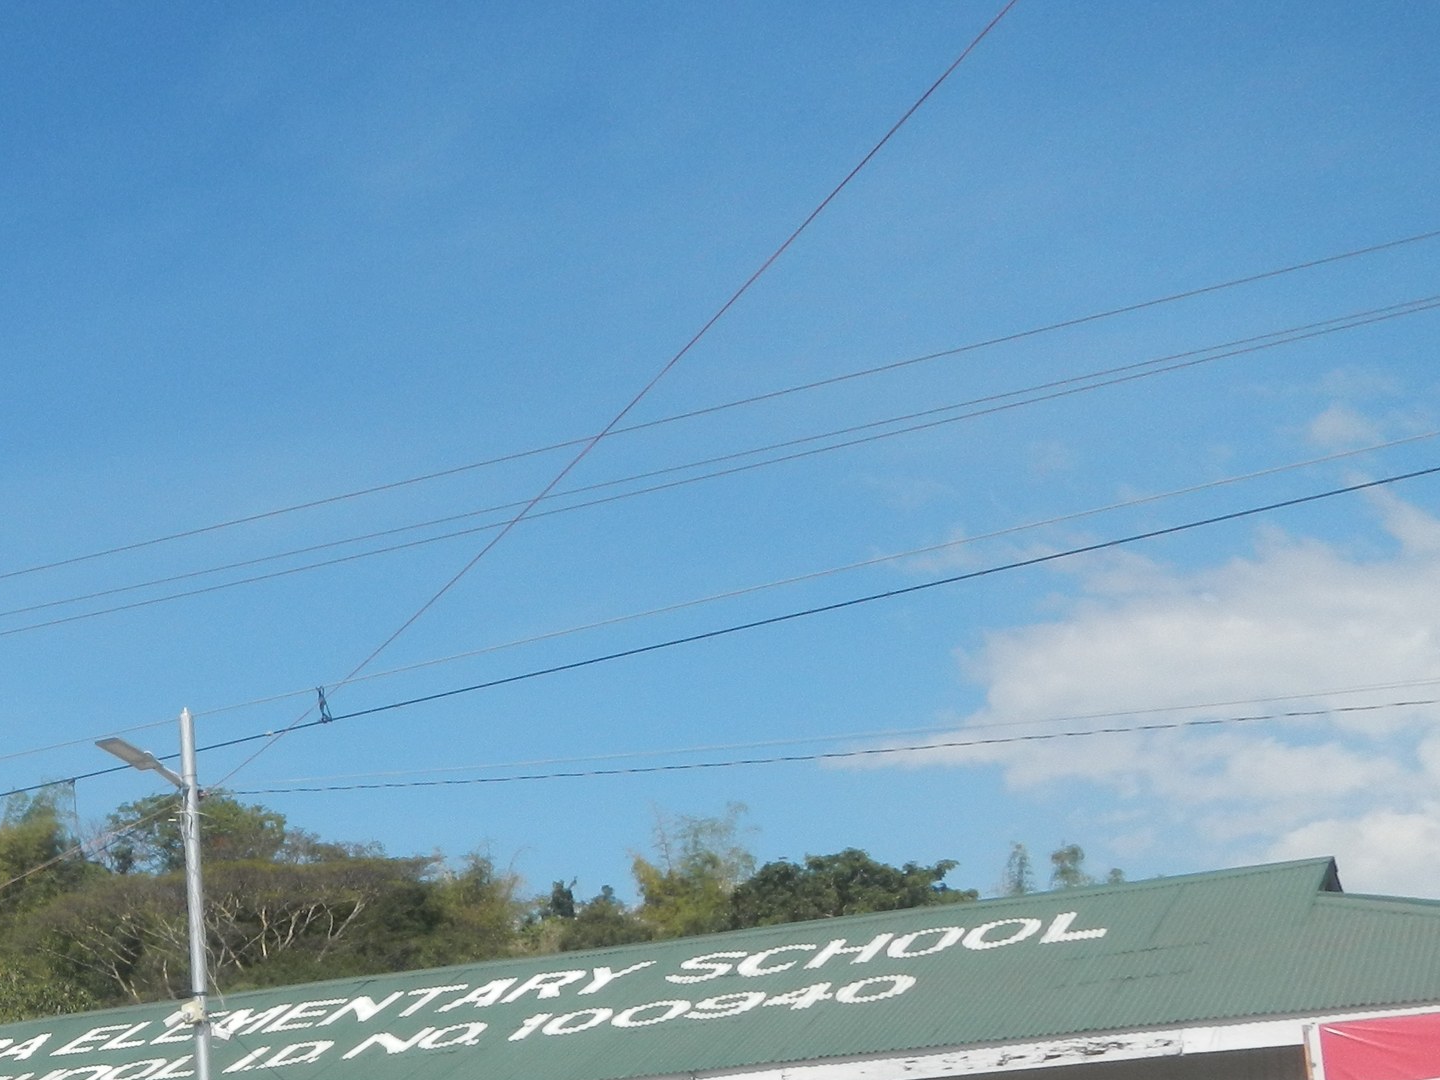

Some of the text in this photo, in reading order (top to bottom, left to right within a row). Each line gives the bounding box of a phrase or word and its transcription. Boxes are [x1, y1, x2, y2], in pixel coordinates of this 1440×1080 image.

[49, 960, 656, 1056] ELEMENTARY
[665, 912, 1108, 984] SCHOOL
[507, 975, 917, 1042] 100940
